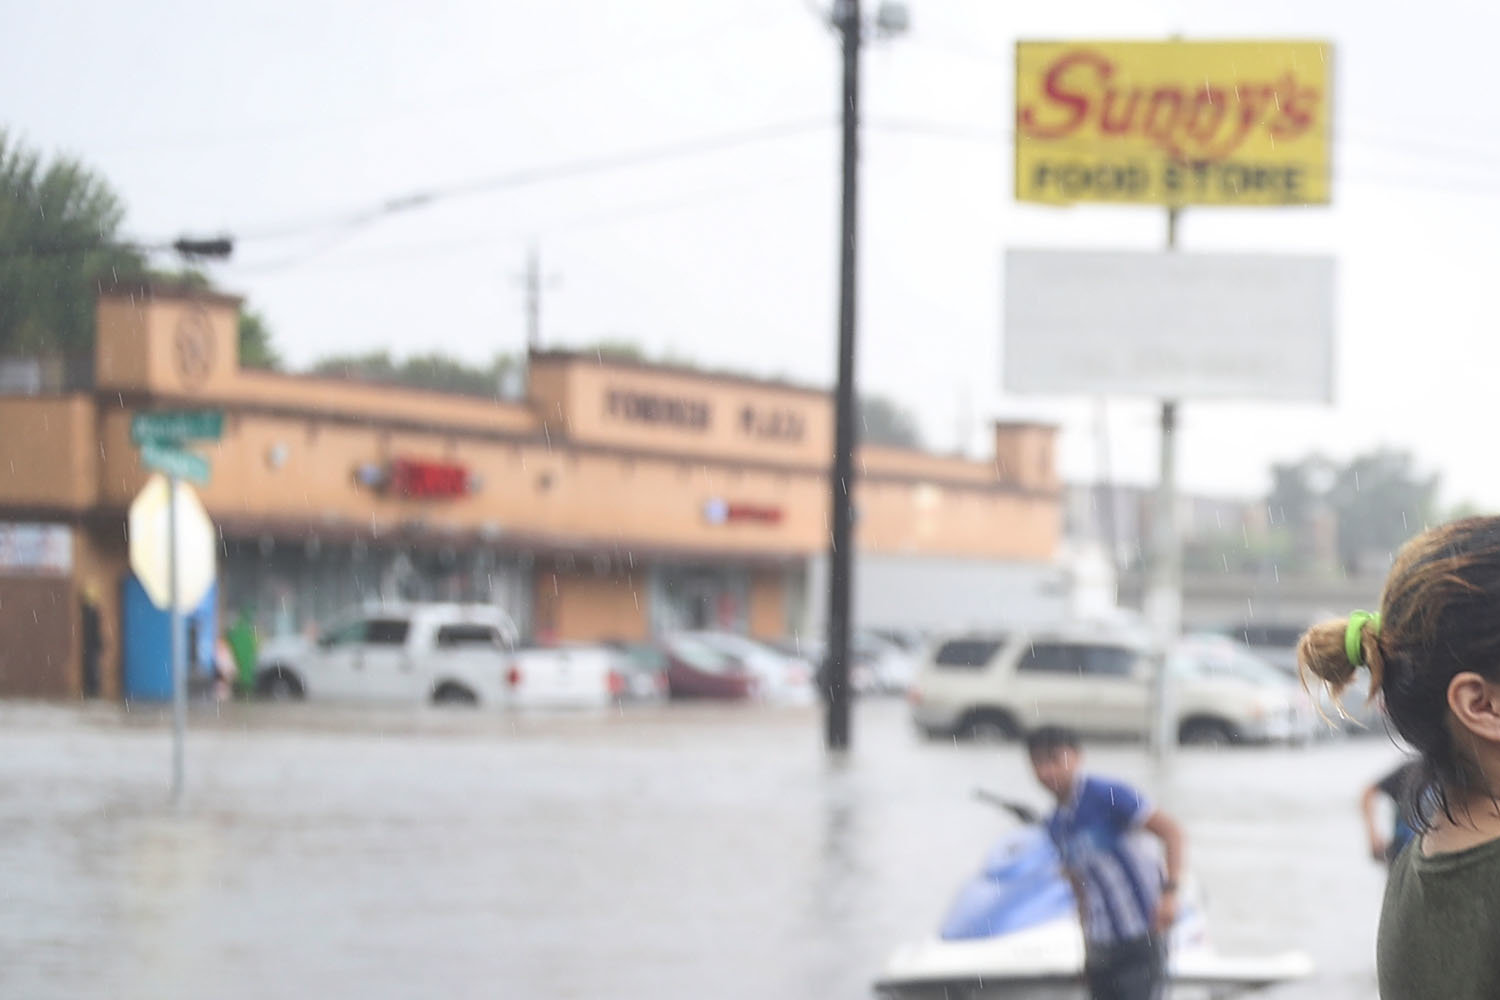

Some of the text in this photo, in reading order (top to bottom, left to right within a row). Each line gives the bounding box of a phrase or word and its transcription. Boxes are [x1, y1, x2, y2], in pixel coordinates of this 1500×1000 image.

[1020, 50, 1319, 167] Sunny's
[1032, 161, 1302, 191] FOOD STORE
